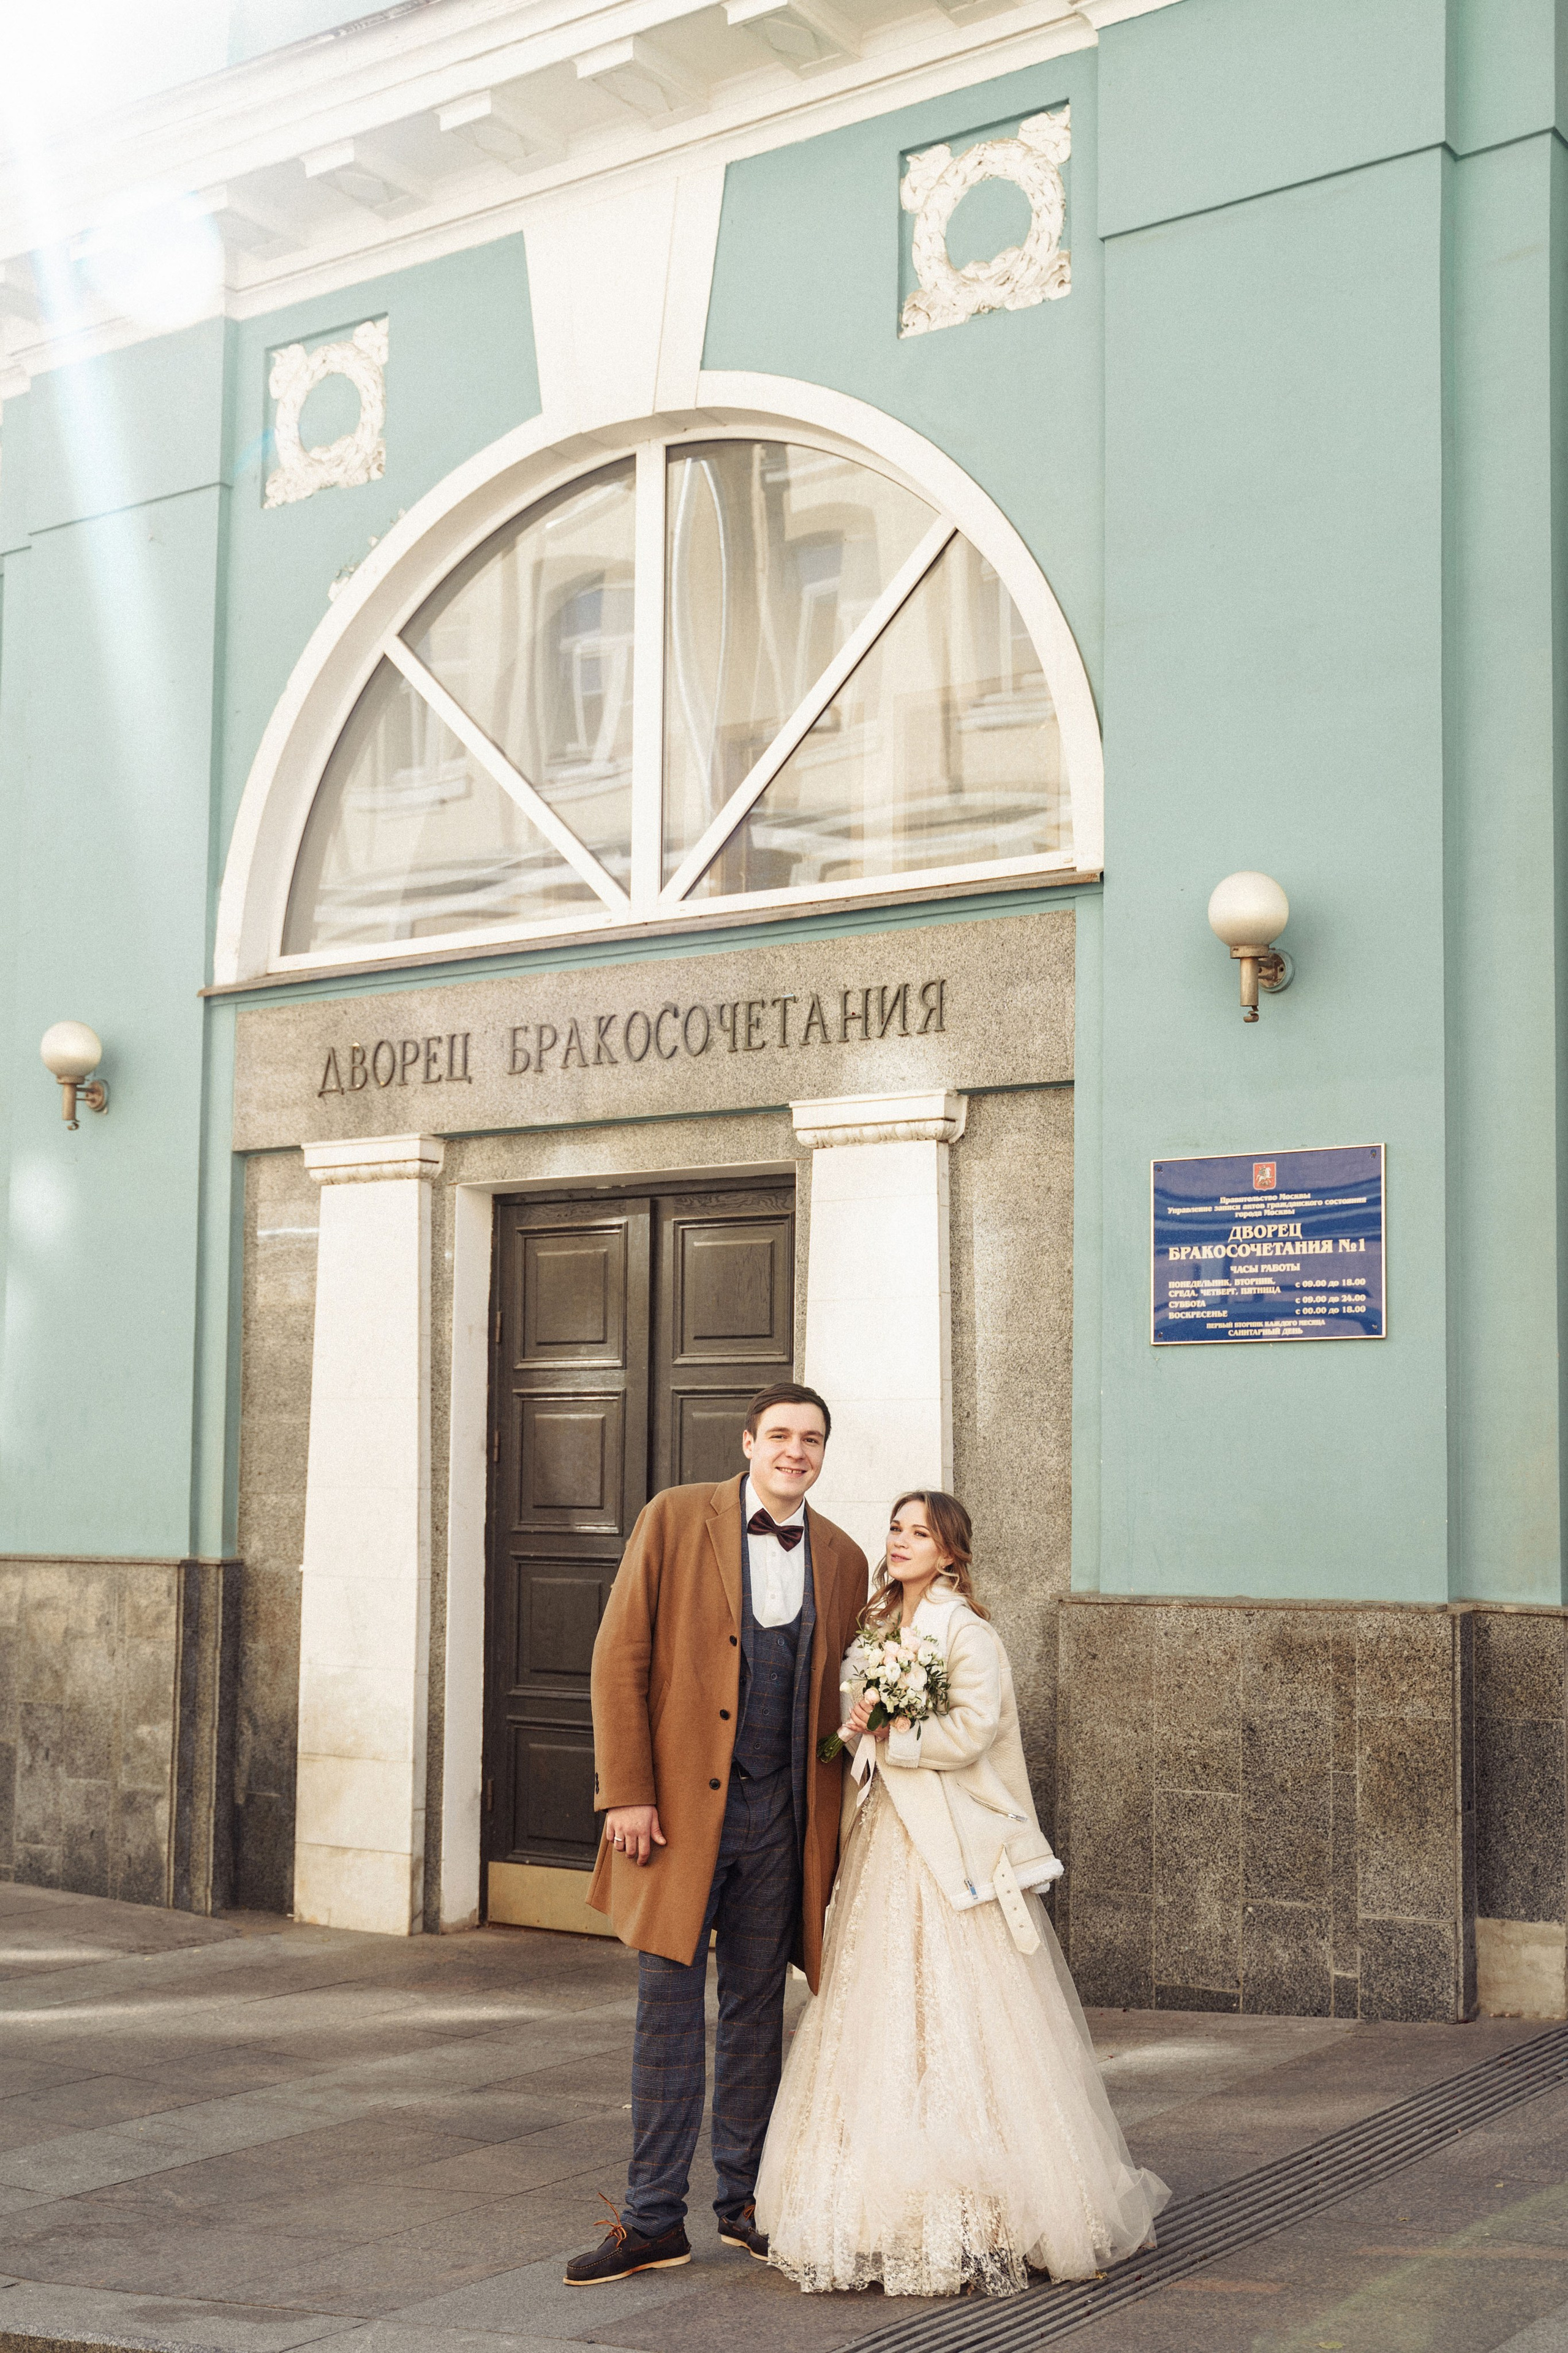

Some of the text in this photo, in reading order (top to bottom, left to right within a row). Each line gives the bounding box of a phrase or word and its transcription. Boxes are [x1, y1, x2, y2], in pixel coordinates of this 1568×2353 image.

[317, 978, 947, 1097] ДВОРЕЦ БРАКОСОЧЕТАНИЯ
[1219, 1195, 1278, 1204] Правительство
[1167, 1206, 1213, 1215] Управление
[1267, 1200, 1323, 1209] гражданского
[1227, 1223, 1303, 1243] ДВОРЕЦ
[1168, 1238, 1366, 1261] БРАКОСОЧЕТАНИЯ №1
[1230, 1263, 1300, 1274] ЧАСЫ РАБОТЫ
[1168, 1279, 1232, 1288] ПОНЕДЕЛЬНИК,
[1342, 1278, 1366, 1286] 18.00
[1200, 1288, 1238, 1296] ЧЕТВЕРГ,
[1240, 1286, 1281, 1295] ПЯТНИЦА
[1302, 1295, 1327, 1304] 09.00
[1341, 1294, 1366, 1302] 24.00
[1168, 1300, 1206, 1309] СУББОТА
[1168, 1310, 1228, 1320] ВОСКРЕСЕНЬЕ
[1228, 1328, 1281, 1336] САНИТАРНЫЙ
